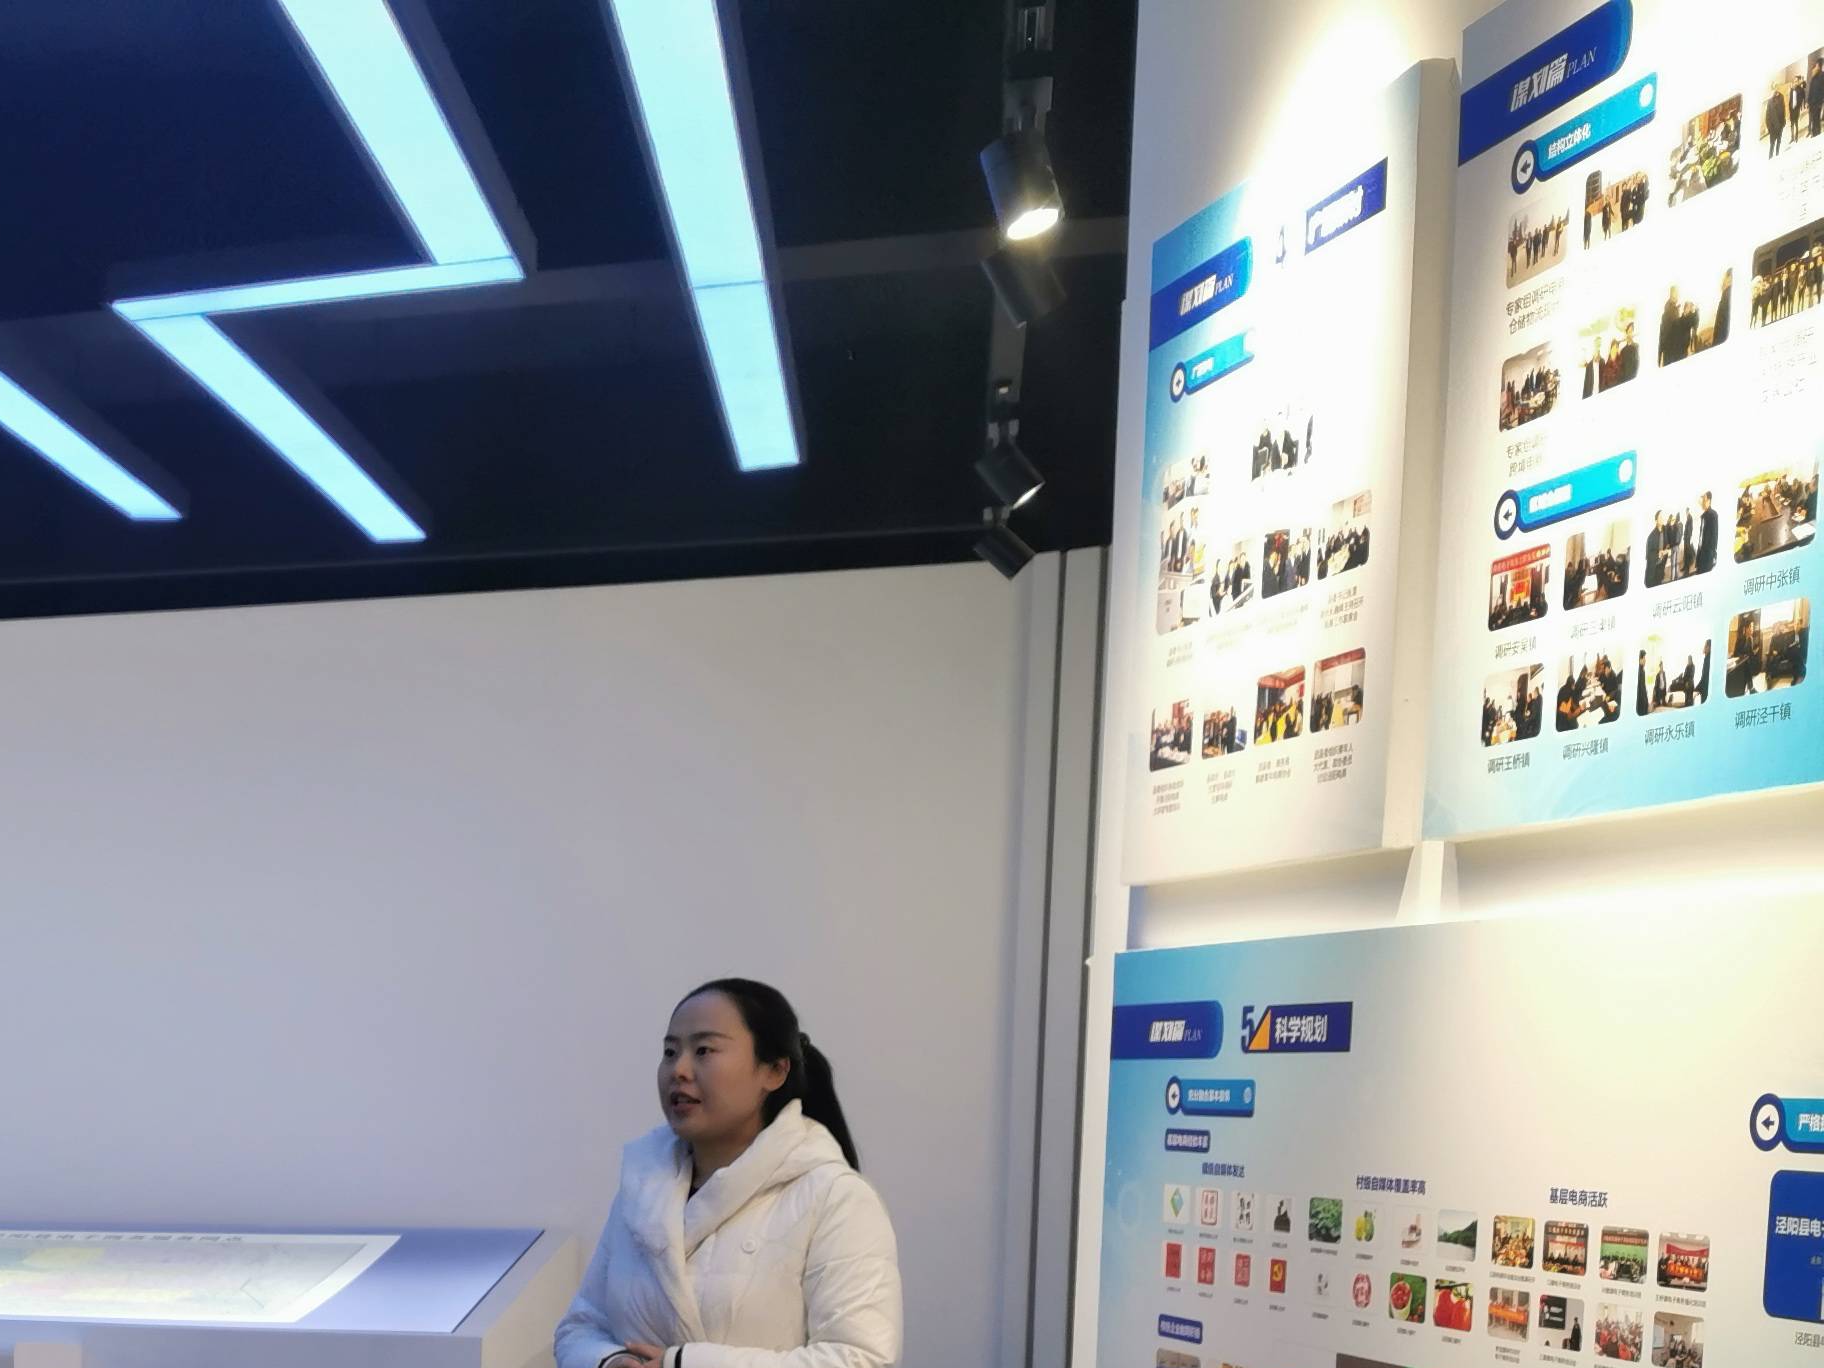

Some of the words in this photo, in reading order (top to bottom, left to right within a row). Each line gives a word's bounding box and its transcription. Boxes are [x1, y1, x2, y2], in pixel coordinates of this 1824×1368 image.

[1510, 53, 1568, 112] 谋划篇
[1567, 46, 1598, 79] PLAN
[1214, 273, 1234, 296] PLAN
[1744, 565, 1801, 597] 调研中张镇
[1734, 702, 1792, 729] 调研泾干镇
[1644, 721, 1696, 746] 调研永乐镇
[1184, 1028, 1203, 1043] PLAN
[1274, 1015, 1328, 1044] 科学规划
[1356, 1175, 1427, 1196] 村级自媒体覆盖率高
[1549, 1187, 1608, 1208] 基层电商活跃
